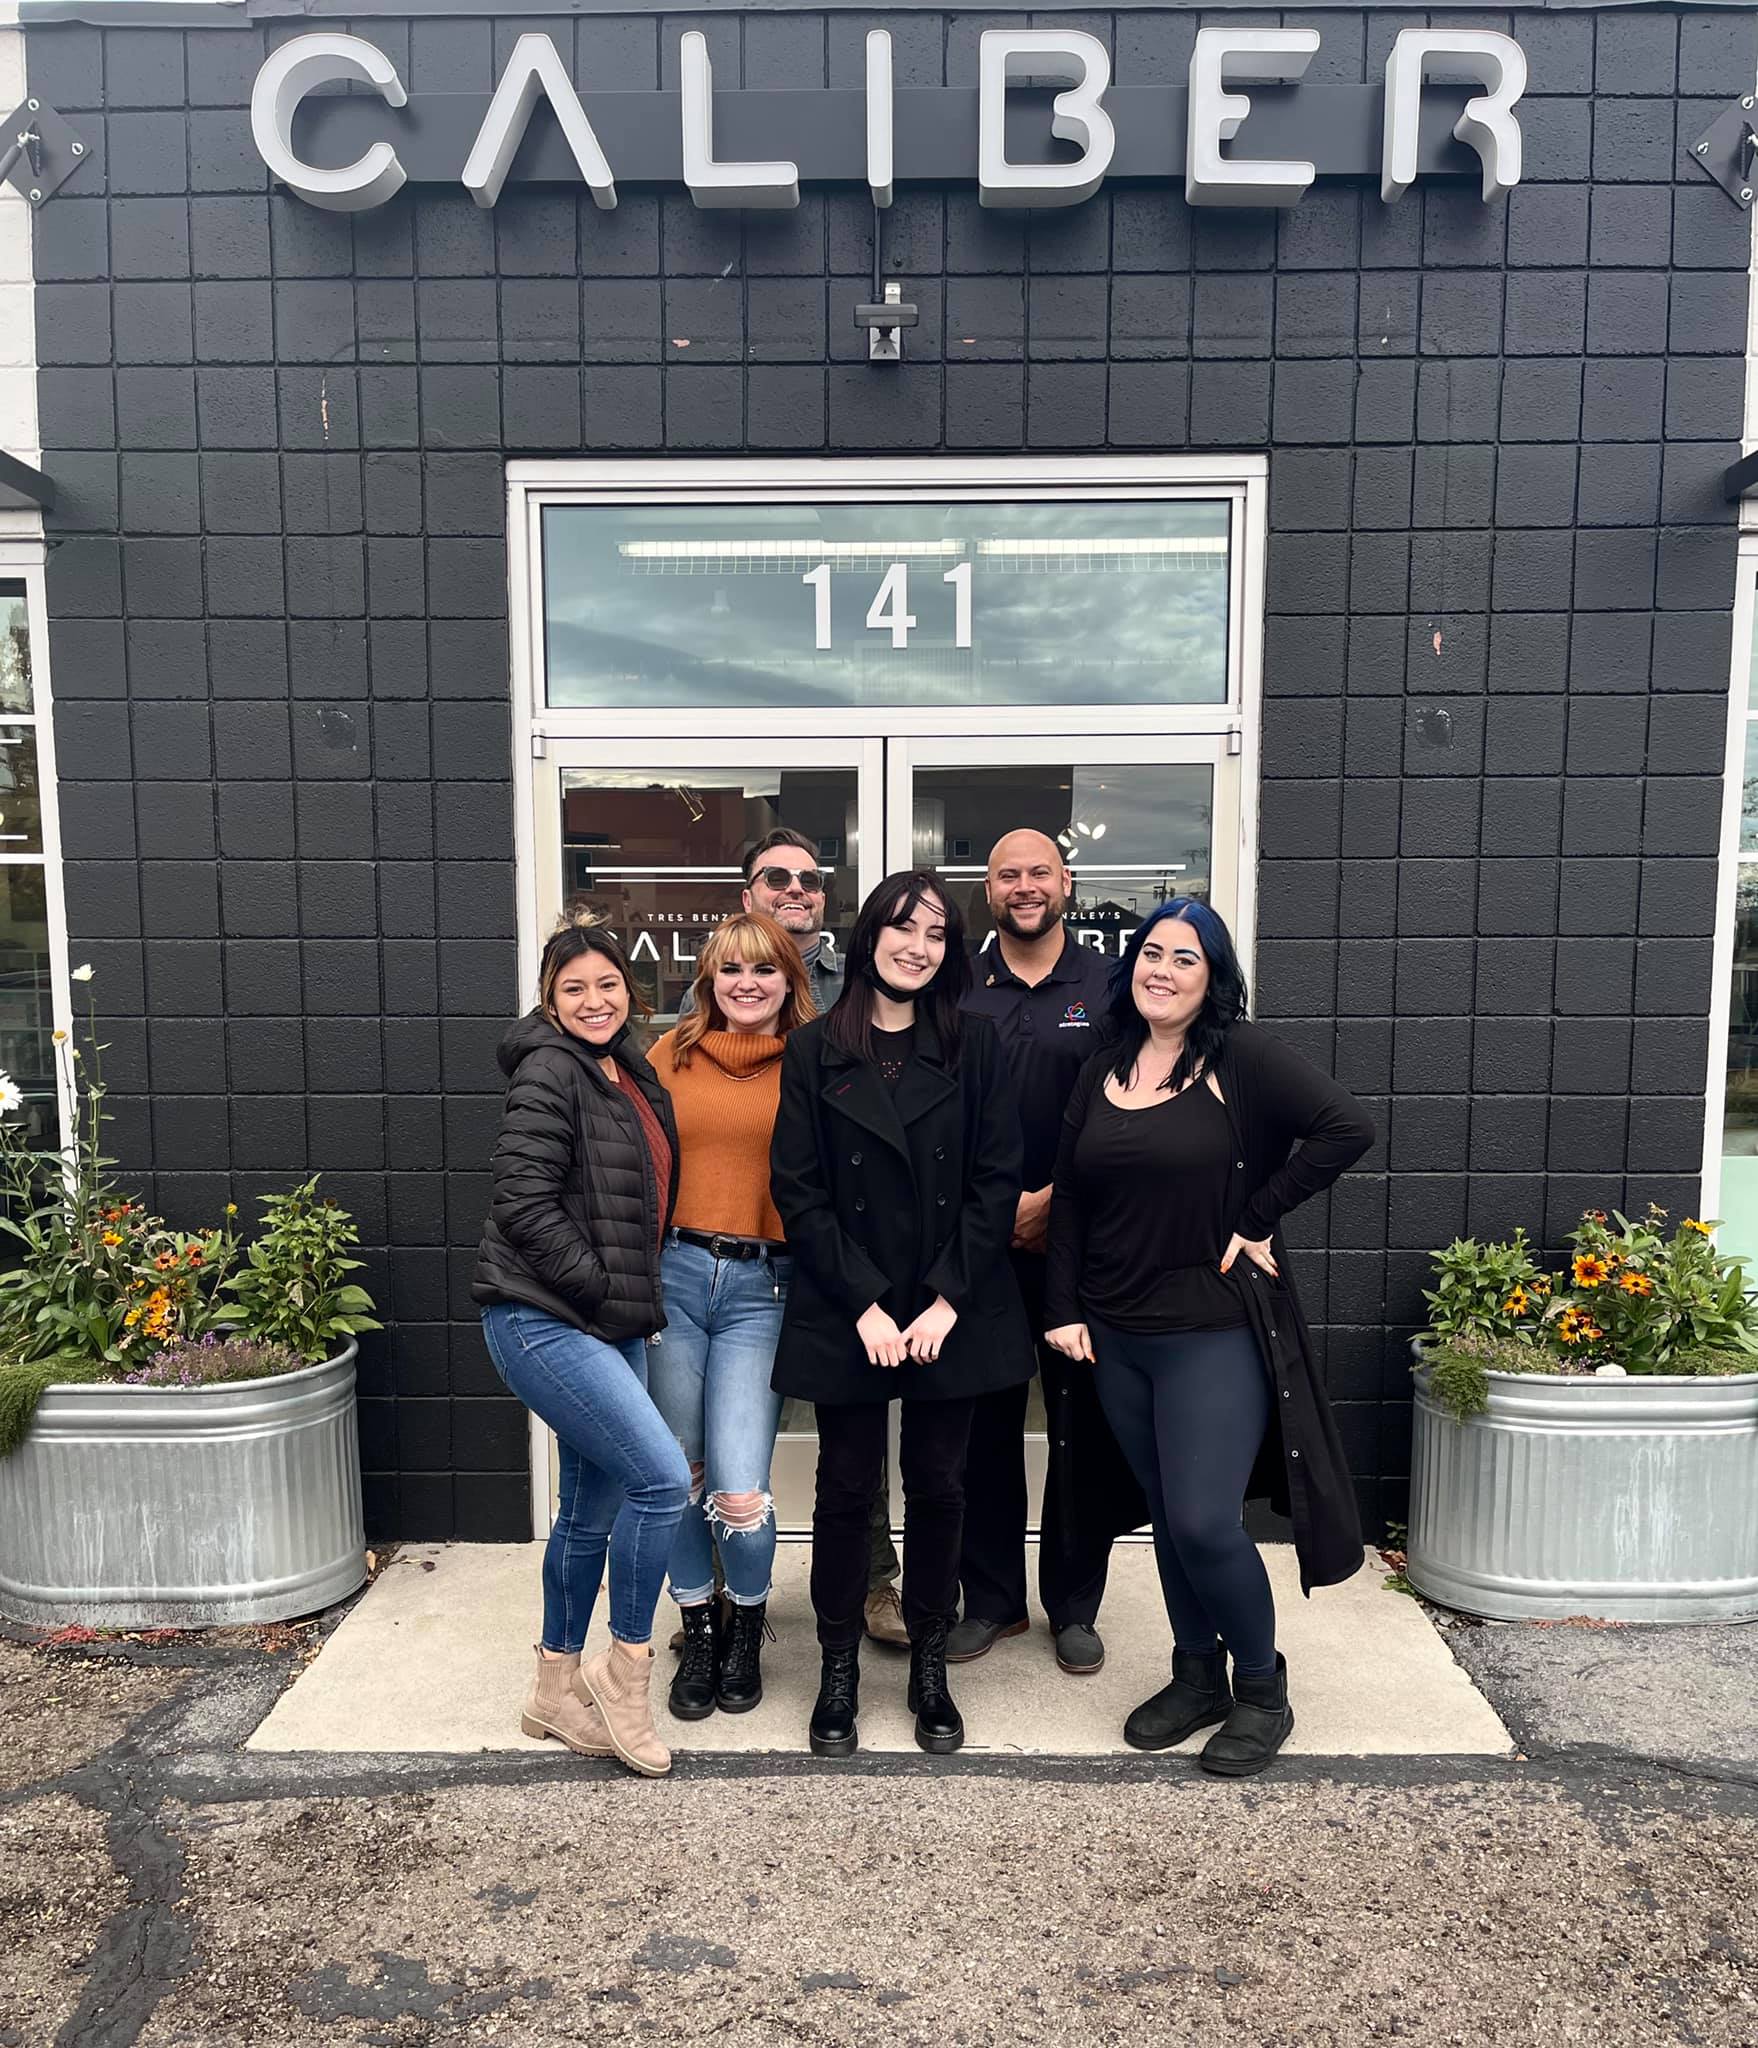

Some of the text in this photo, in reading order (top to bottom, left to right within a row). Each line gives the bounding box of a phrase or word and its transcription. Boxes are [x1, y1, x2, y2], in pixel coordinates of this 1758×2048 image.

[250, 28, 1529, 212] CALIBER
[802, 562, 972, 650] 141
[647, 913, 684, 922] TRES
[1062, 911, 1121, 920] NZLEY'S
